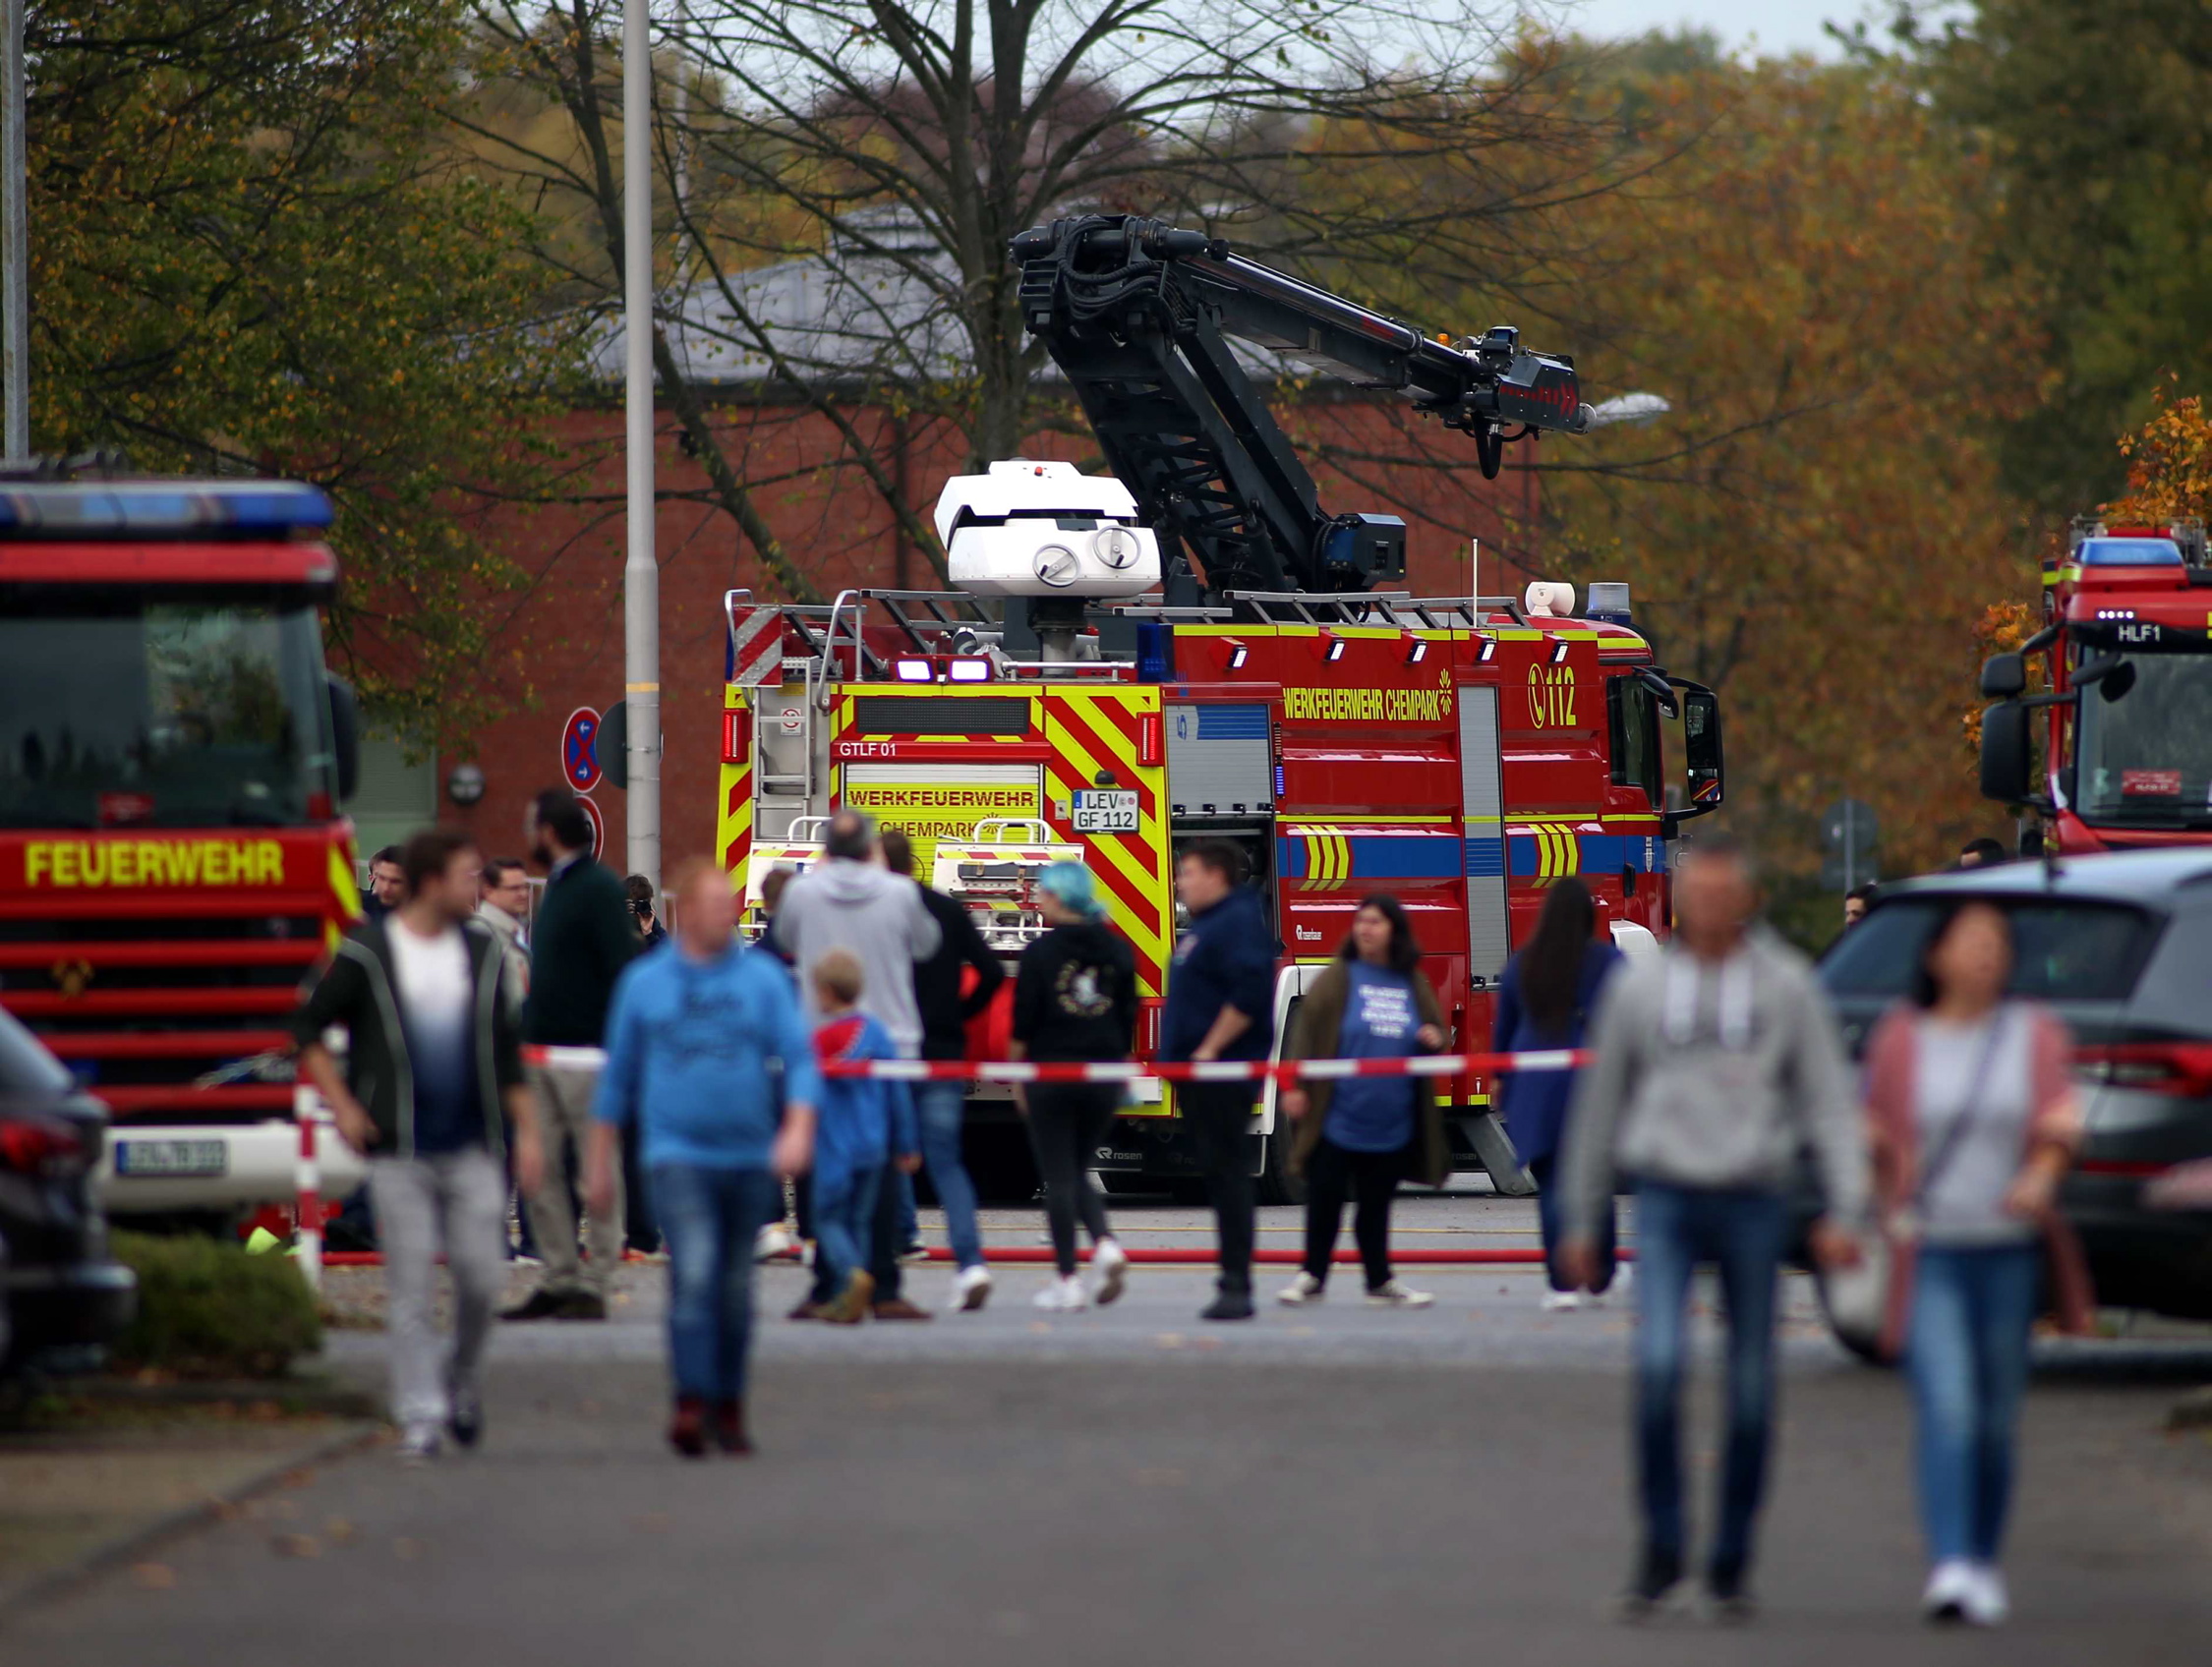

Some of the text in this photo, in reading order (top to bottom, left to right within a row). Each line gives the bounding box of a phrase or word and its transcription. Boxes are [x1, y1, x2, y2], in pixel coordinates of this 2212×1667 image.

[2118, 624, 2161, 642] HLF1
[1283, 687, 1441, 721] WERKFEUERWEHR CHEMPARK
[1546, 666, 1577, 726] 112
[840, 742, 897, 757] GTLF 01
[849, 790, 1034, 807] WERKFEUERWEHR
[1086, 793, 1119, 809] LEV
[1078, 812, 1134, 828] GF 112
[26, 840, 285, 886] FEUERWEHR
